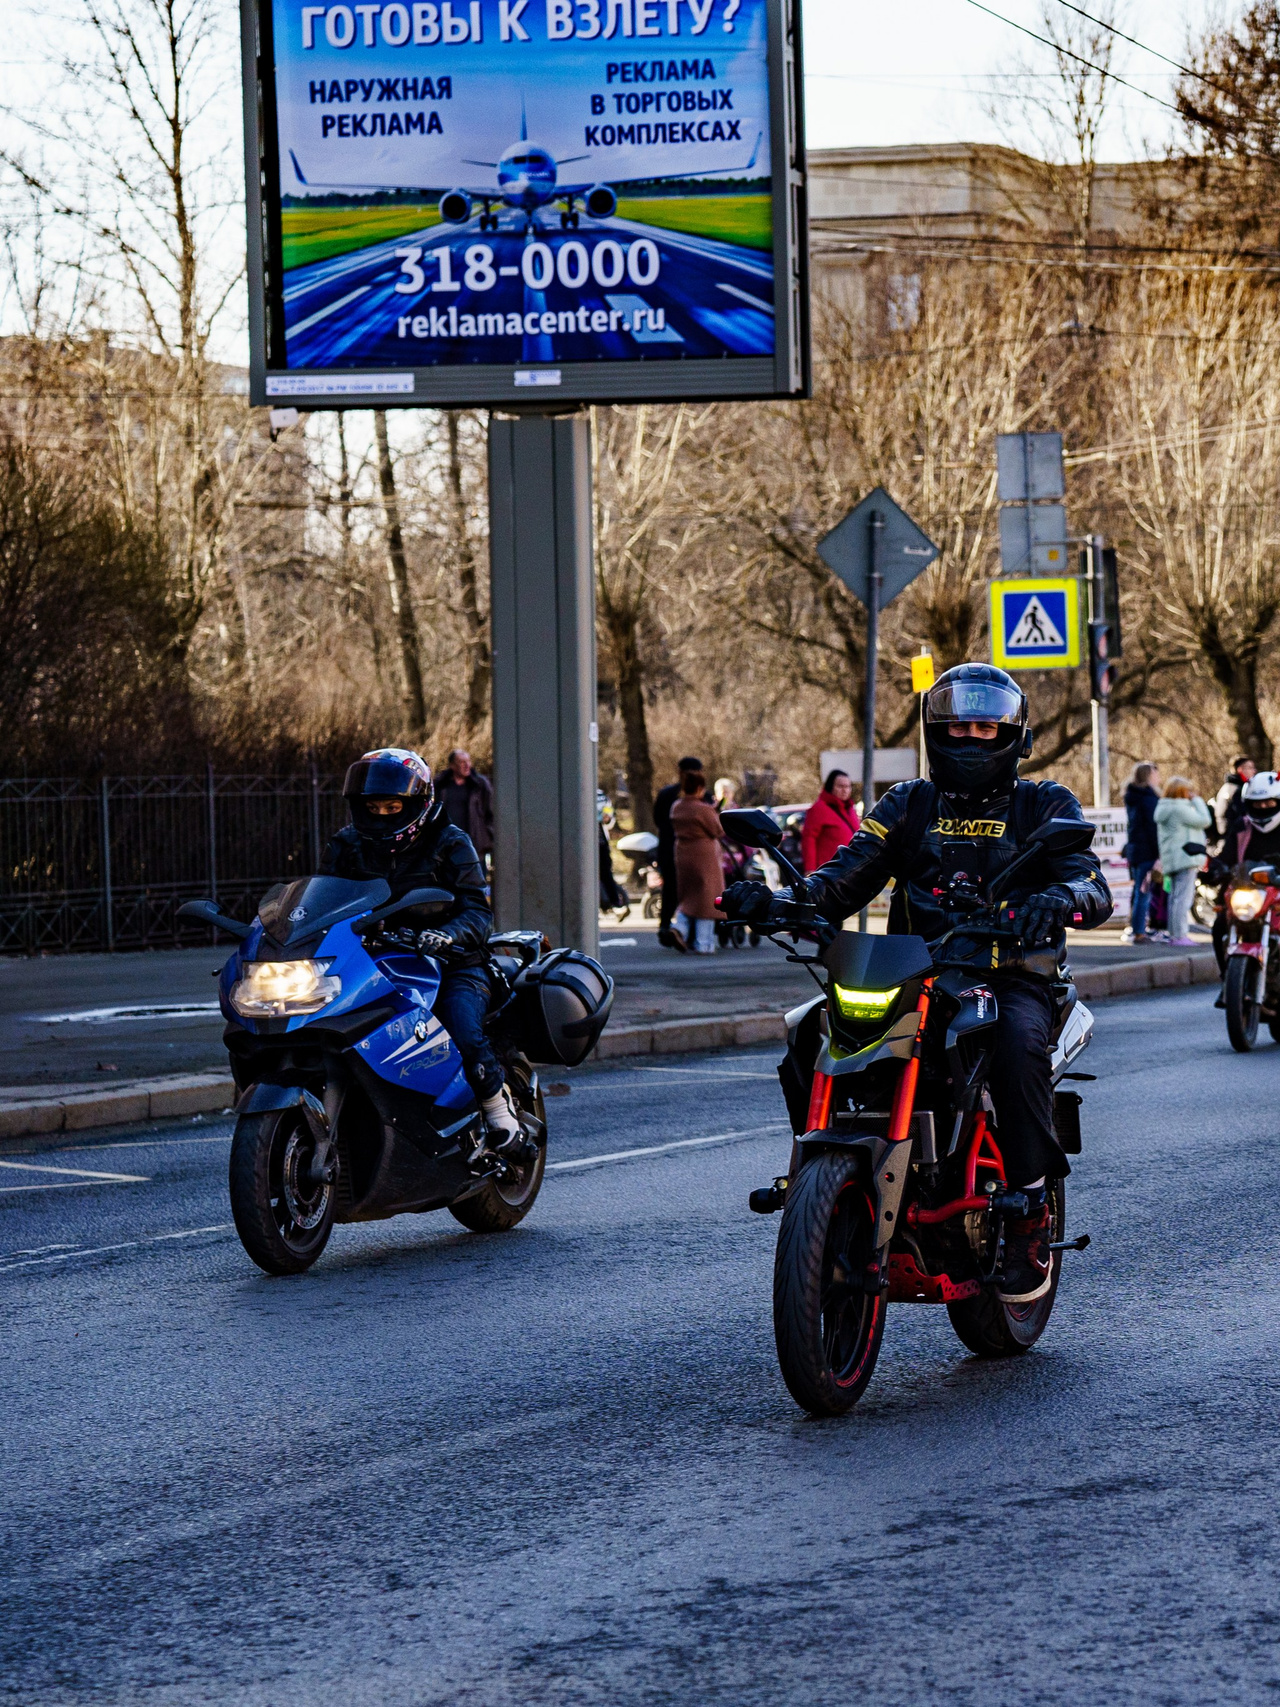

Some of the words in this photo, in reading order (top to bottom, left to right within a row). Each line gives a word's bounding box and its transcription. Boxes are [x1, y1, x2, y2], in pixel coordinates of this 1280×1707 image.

[301, 1, 482, 48] ГОТОВЫ
[498, 0, 531, 41] К
[546, 0, 740, 40] ВЗЛЕТУ?
[606, 58, 716, 84] РЕКЛАМА
[309, 76, 453, 104] НАРУЖНАЯ
[591, 94, 605, 115] В
[612, 88, 734, 114] ТОРГОВЫХ
[322, 111, 443, 138] РЕКЛАМА
[584, 119, 742, 147] КОМПЛЕКСАХ
[394, 239, 660, 294] 318-0000
[398, 306, 665, 338] reklamacenter.ru
